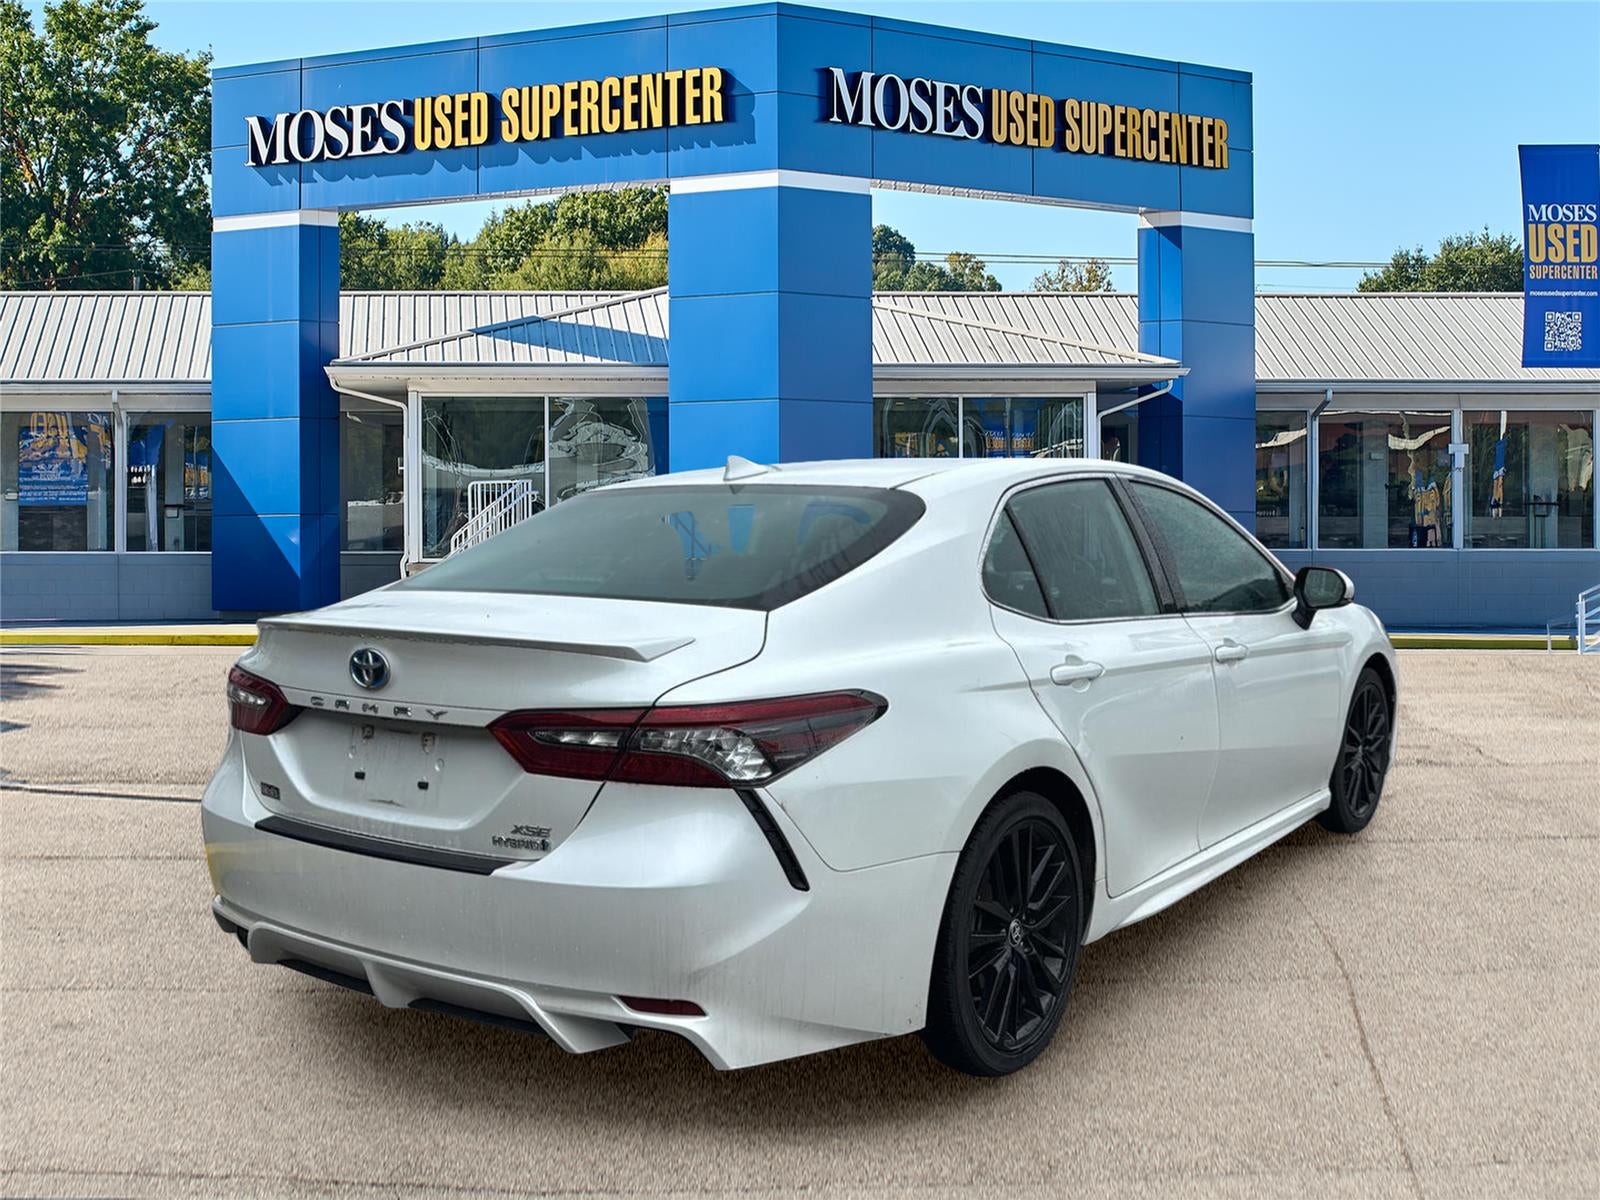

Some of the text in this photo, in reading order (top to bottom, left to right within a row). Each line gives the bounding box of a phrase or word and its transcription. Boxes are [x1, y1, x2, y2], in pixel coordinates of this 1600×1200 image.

[245, 67, 725, 167] MOSES USED SUPERCENTER
[829, 67, 1230, 169] MOSES USED SUPERCENTER
[1528, 203, 1597, 222] MOSES
[1528, 223, 1598, 263] USED
[1529, 265, 1598, 279] SUPERCENTER
[310, 695, 448, 720] CAMRY
[511, 824, 552, 838] XSE
